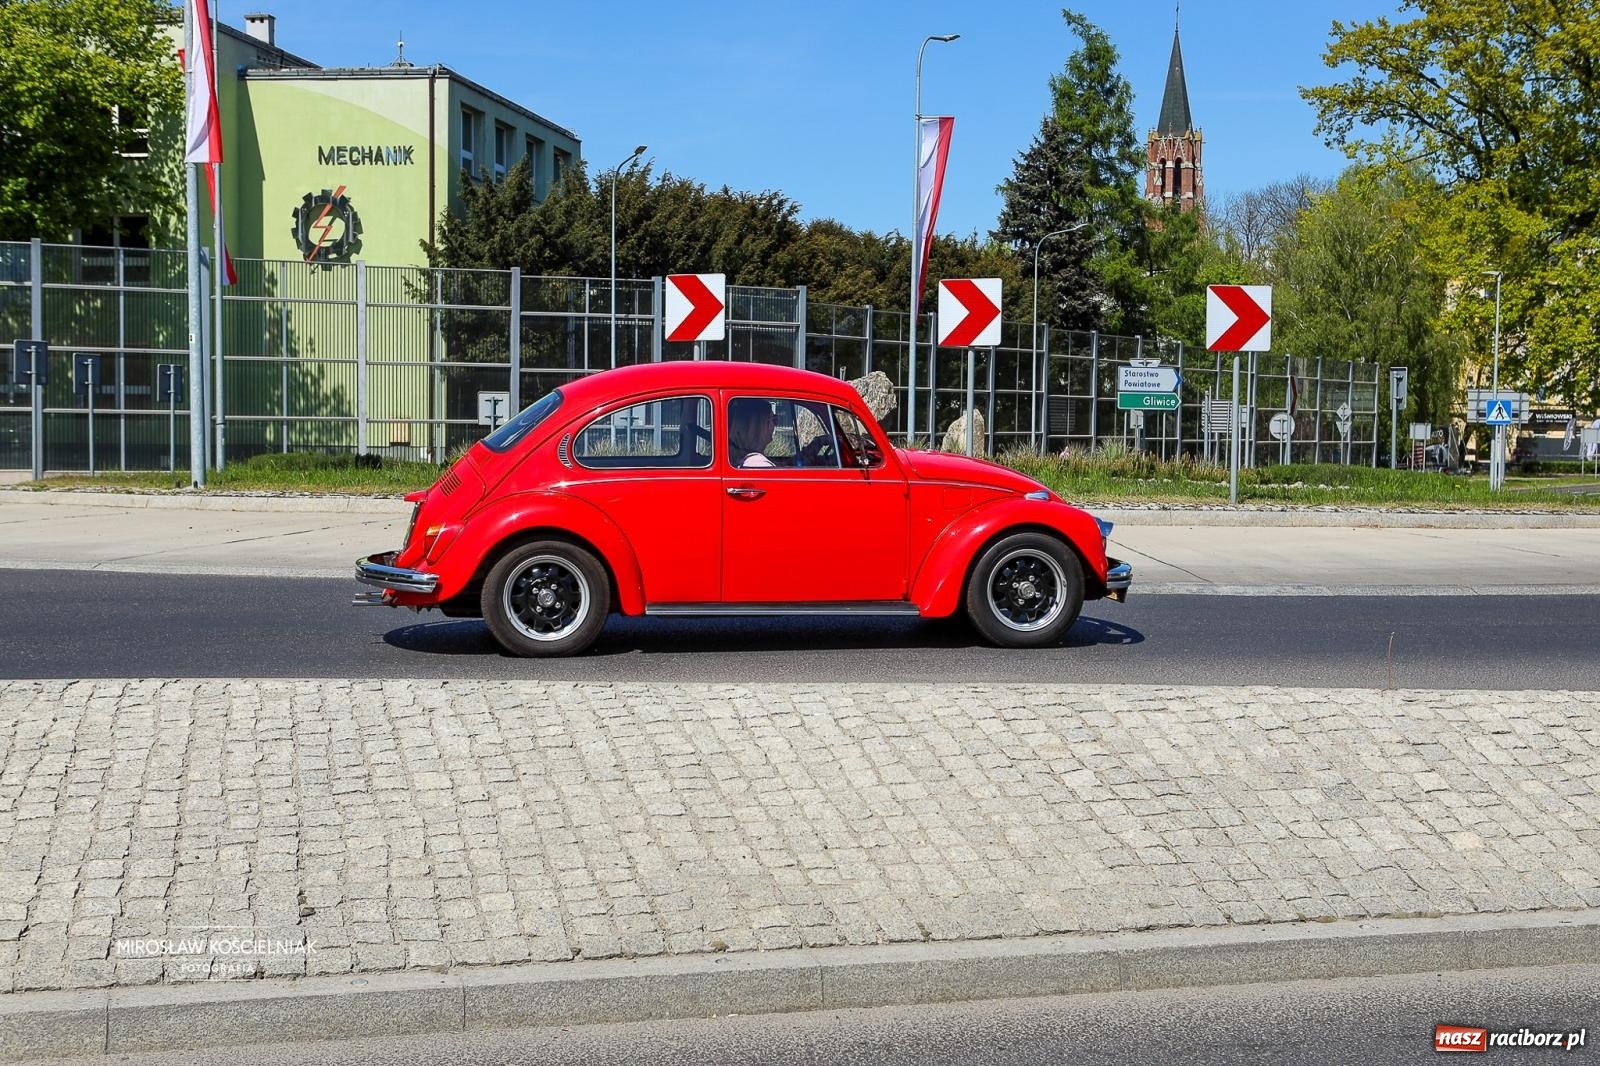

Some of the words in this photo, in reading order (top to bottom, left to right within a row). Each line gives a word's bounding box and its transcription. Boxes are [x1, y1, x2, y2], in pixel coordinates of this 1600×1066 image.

[318, 145, 415, 166] MECHANIK
[1124, 370, 1159, 378] Starostwo
[1124, 380, 1161, 388] Powiatowe
[1143, 396, 1176, 406] Gliwice
